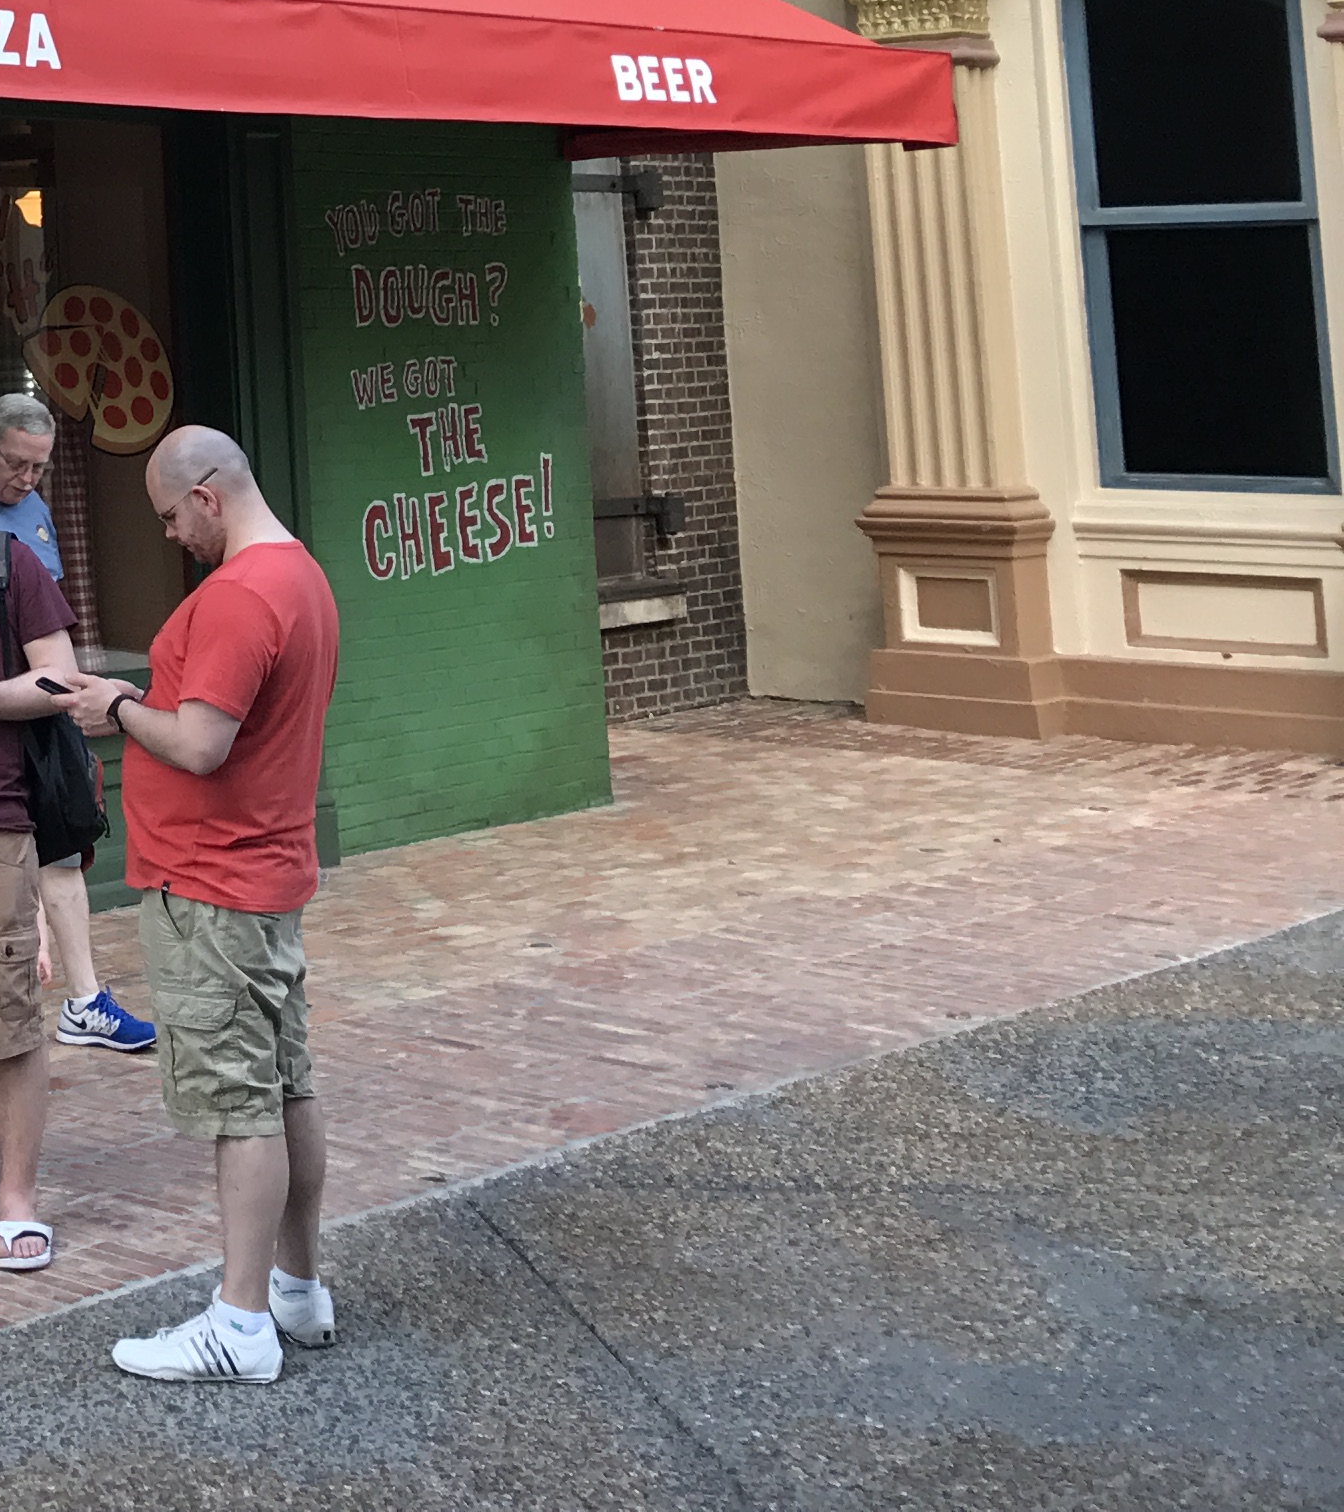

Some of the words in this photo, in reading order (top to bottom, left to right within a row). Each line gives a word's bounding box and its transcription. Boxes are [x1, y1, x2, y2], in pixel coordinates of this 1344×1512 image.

[611, 54, 717, 104] BEER
[325, 199, 380, 257] YOU
[387, 188, 441, 238] GOT
[456, 193, 507, 236] THE
[350, 262, 508, 328] DOUGH?
[350, 362, 398, 410] WE
[403, 356, 457, 398] GOT
[407, 403, 487, 477] THE
[362, 452, 555, 581] CHEESE!
